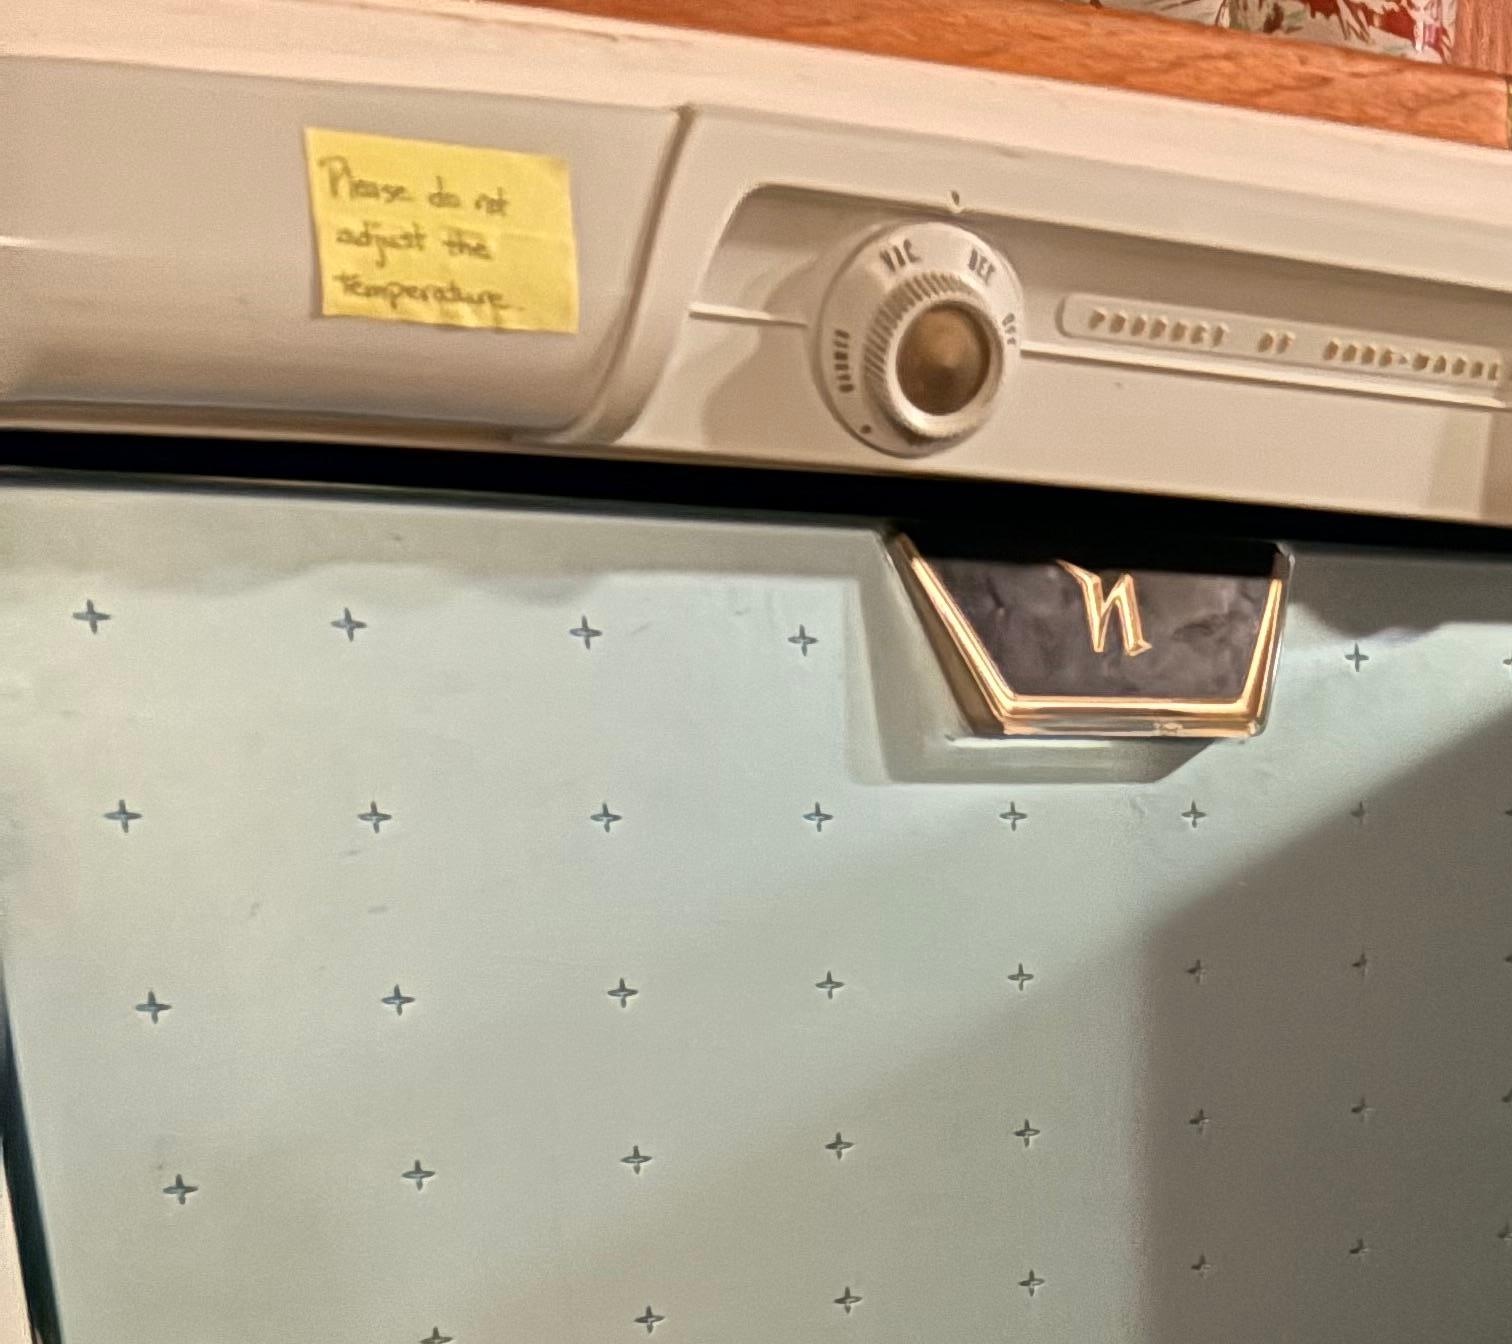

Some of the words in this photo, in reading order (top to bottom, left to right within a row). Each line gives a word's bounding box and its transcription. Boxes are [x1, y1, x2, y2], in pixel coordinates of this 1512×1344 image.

[317, 155, 415, 204] Please
[428, 175, 461, 209] do
[475, 186, 510, 217] not
[336, 220, 427, 269] adjust
[442, 228, 493, 261] the
